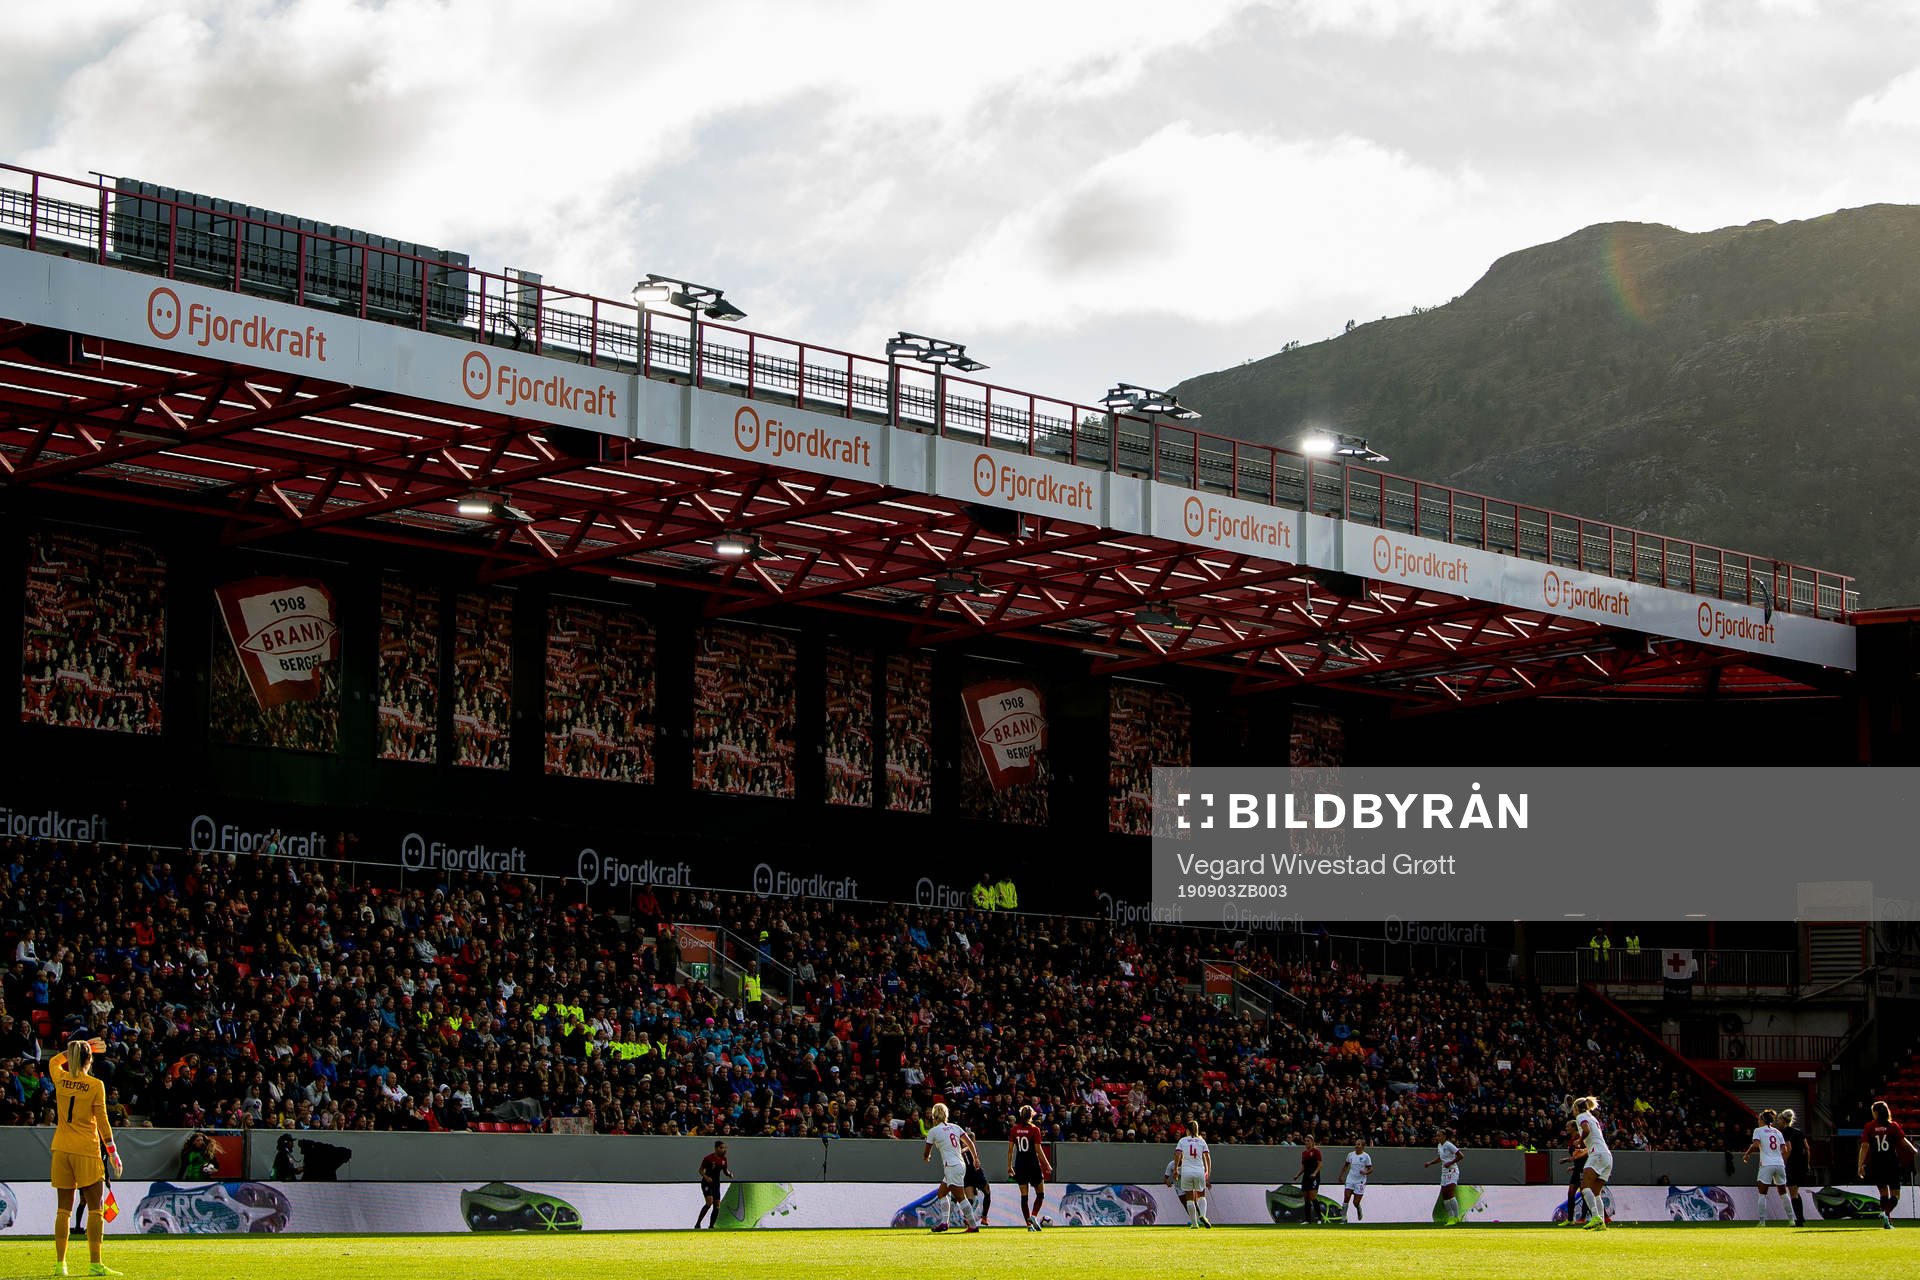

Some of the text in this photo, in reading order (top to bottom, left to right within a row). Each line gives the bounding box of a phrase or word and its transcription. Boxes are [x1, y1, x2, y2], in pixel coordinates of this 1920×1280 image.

[188, 303, 326, 361] Fjordkraft
[496, 365, 617, 418] Fjordkraft
[765, 419, 871, 467] Fjordkraft
[1000, 466, 1093, 511] Fjordkraft
[1208, 507, 1291, 548] Fjordkraft
[1395, 545, 1469, 584] Fjordkraft
[270, 595, 306, 613] 1908
[1562, 580, 1630, 616] Fjordkraft
[260, 620, 325, 652] BRANN
[1714, 611, 1775, 644] Fjordkraft
[279, 652, 322, 672] BERGE
[999, 696, 1025, 712] 1908
[993, 716, 1038, 743] BRANN
[1006, 744, 1036, 760] BERGE
[430, 841, 527, 873] Fjordkraft
[603, 856, 692, 888] Fjordkraft
[776, 871, 859, 900] Fjordkraft
[1115, 900, 1183, 927] Fjordkraft
[1406, 920, 1487, 946] Fjordkraft
[62, 1079, 90, 1092] TELFORD
[67, 1095, 75, 1123] 1
[1015, 1135, 1030, 1153] 10
[1189, 1144, 1198, 1159] 4
[1769, 1135, 1777, 1151] 8
[1875, 1133, 1890, 1152] 16
